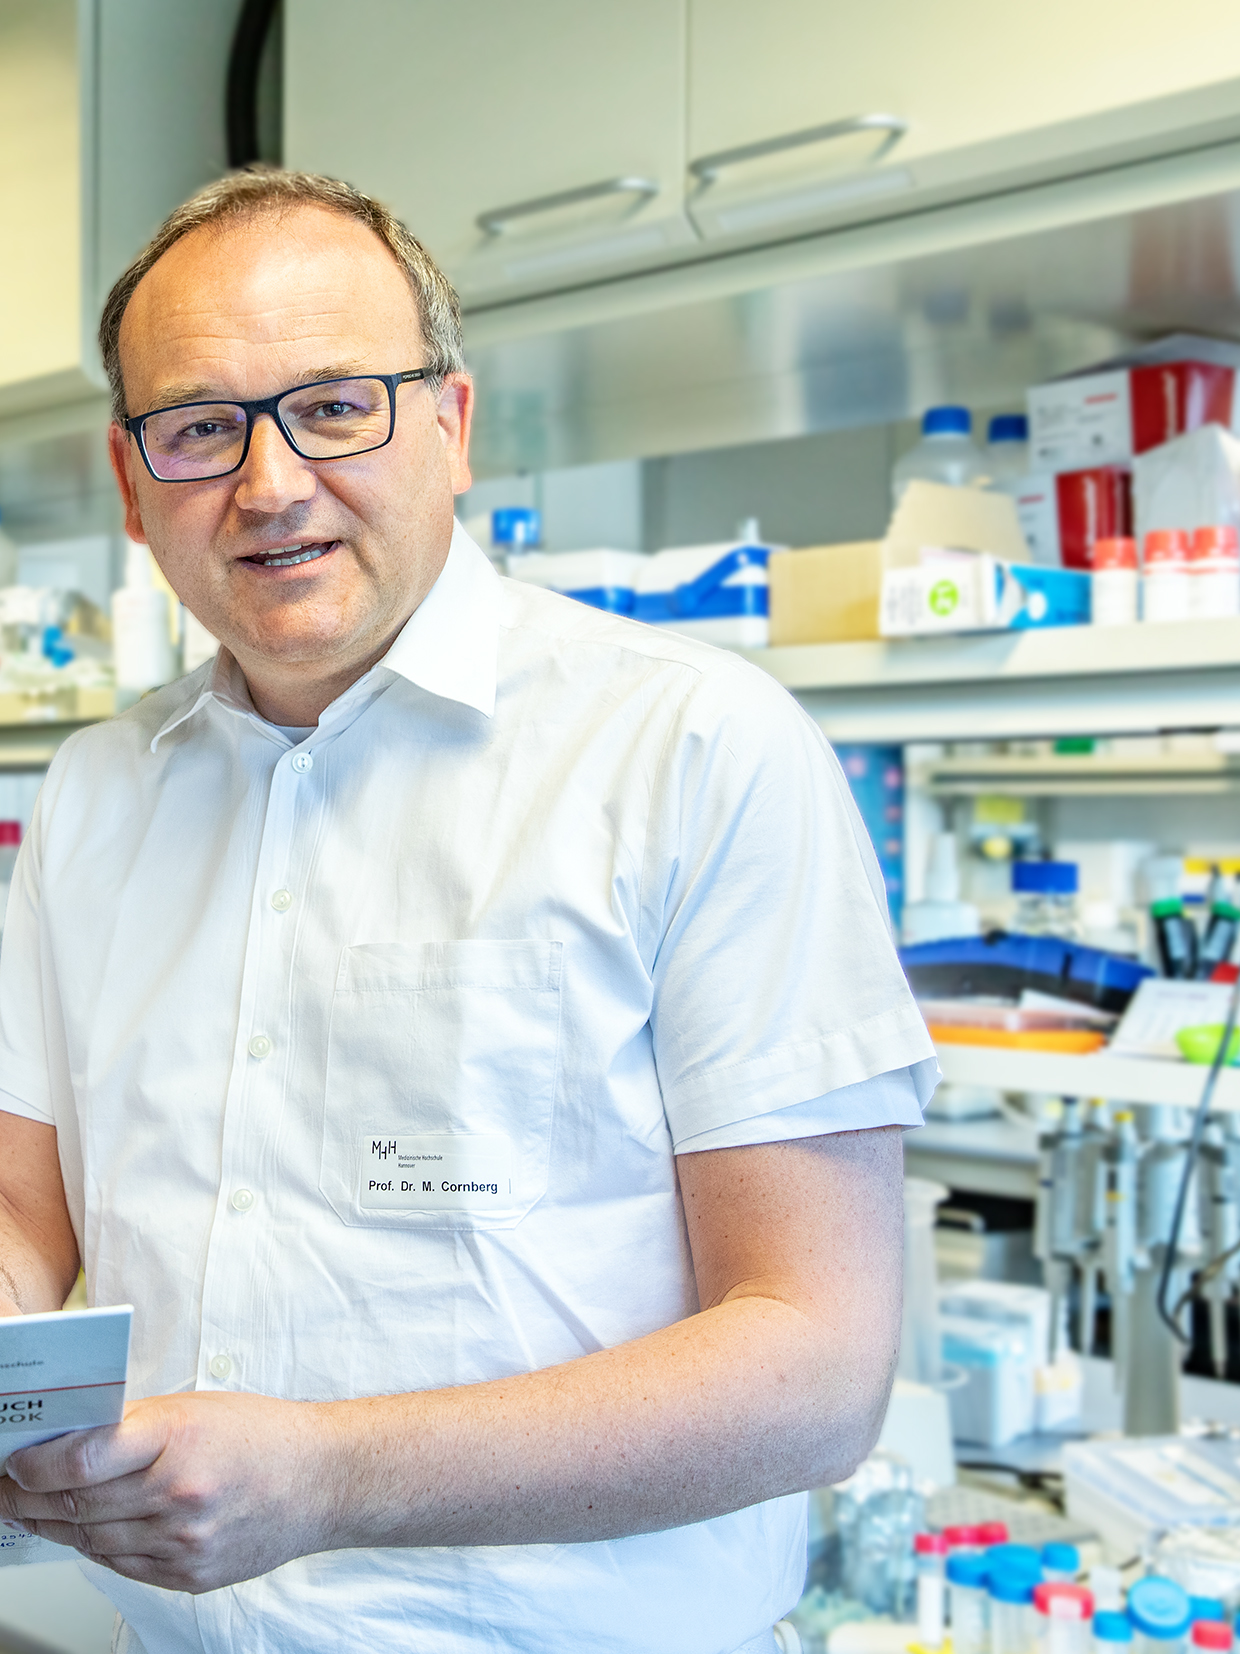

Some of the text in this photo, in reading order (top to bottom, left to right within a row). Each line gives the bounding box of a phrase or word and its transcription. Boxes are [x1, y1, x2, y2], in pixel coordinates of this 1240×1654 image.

[371, 1140, 397, 1160] MHH
[368, 1180, 498, 1195] Prof. Dr. M. Cornberg
